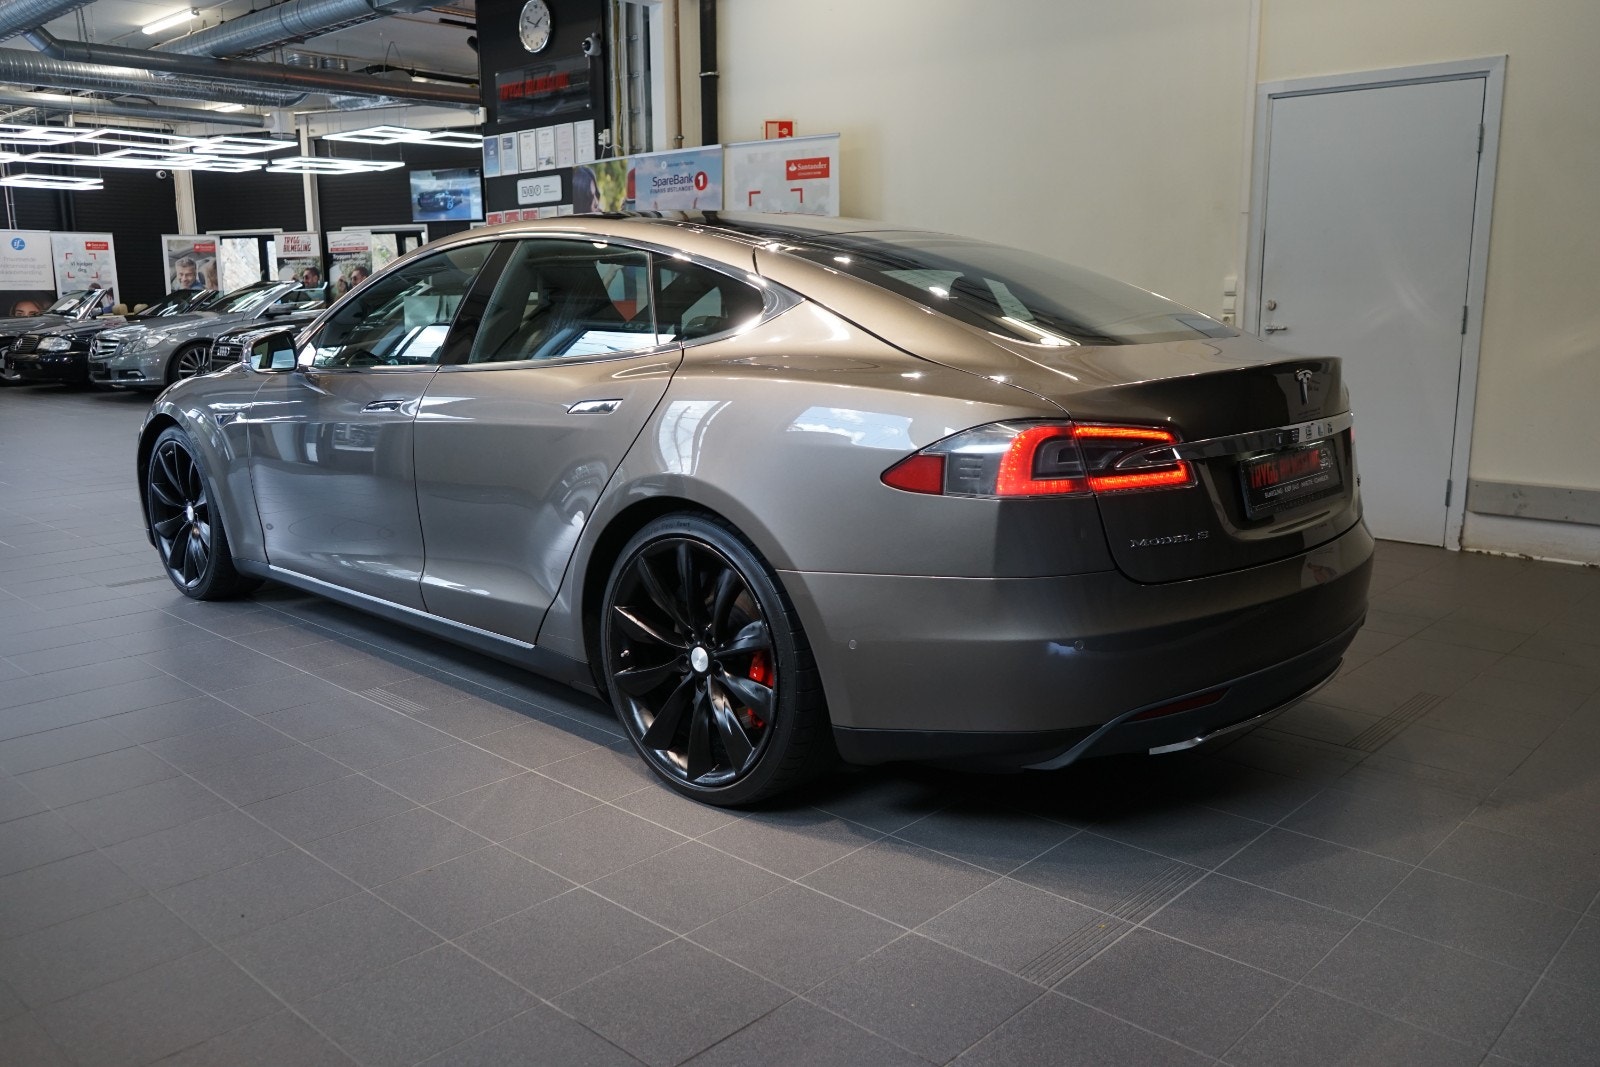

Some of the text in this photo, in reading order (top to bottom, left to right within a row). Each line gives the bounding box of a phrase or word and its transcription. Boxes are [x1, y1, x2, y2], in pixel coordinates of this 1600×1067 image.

[798, 161, 827, 171] Santander
[652, 173, 694, 188] SpareBank
[284, 236, 300, 244] TRYGG
[283, 243, 312, 252] BILMEGLING
[1129, 530, 1209, 548] MODEL S
